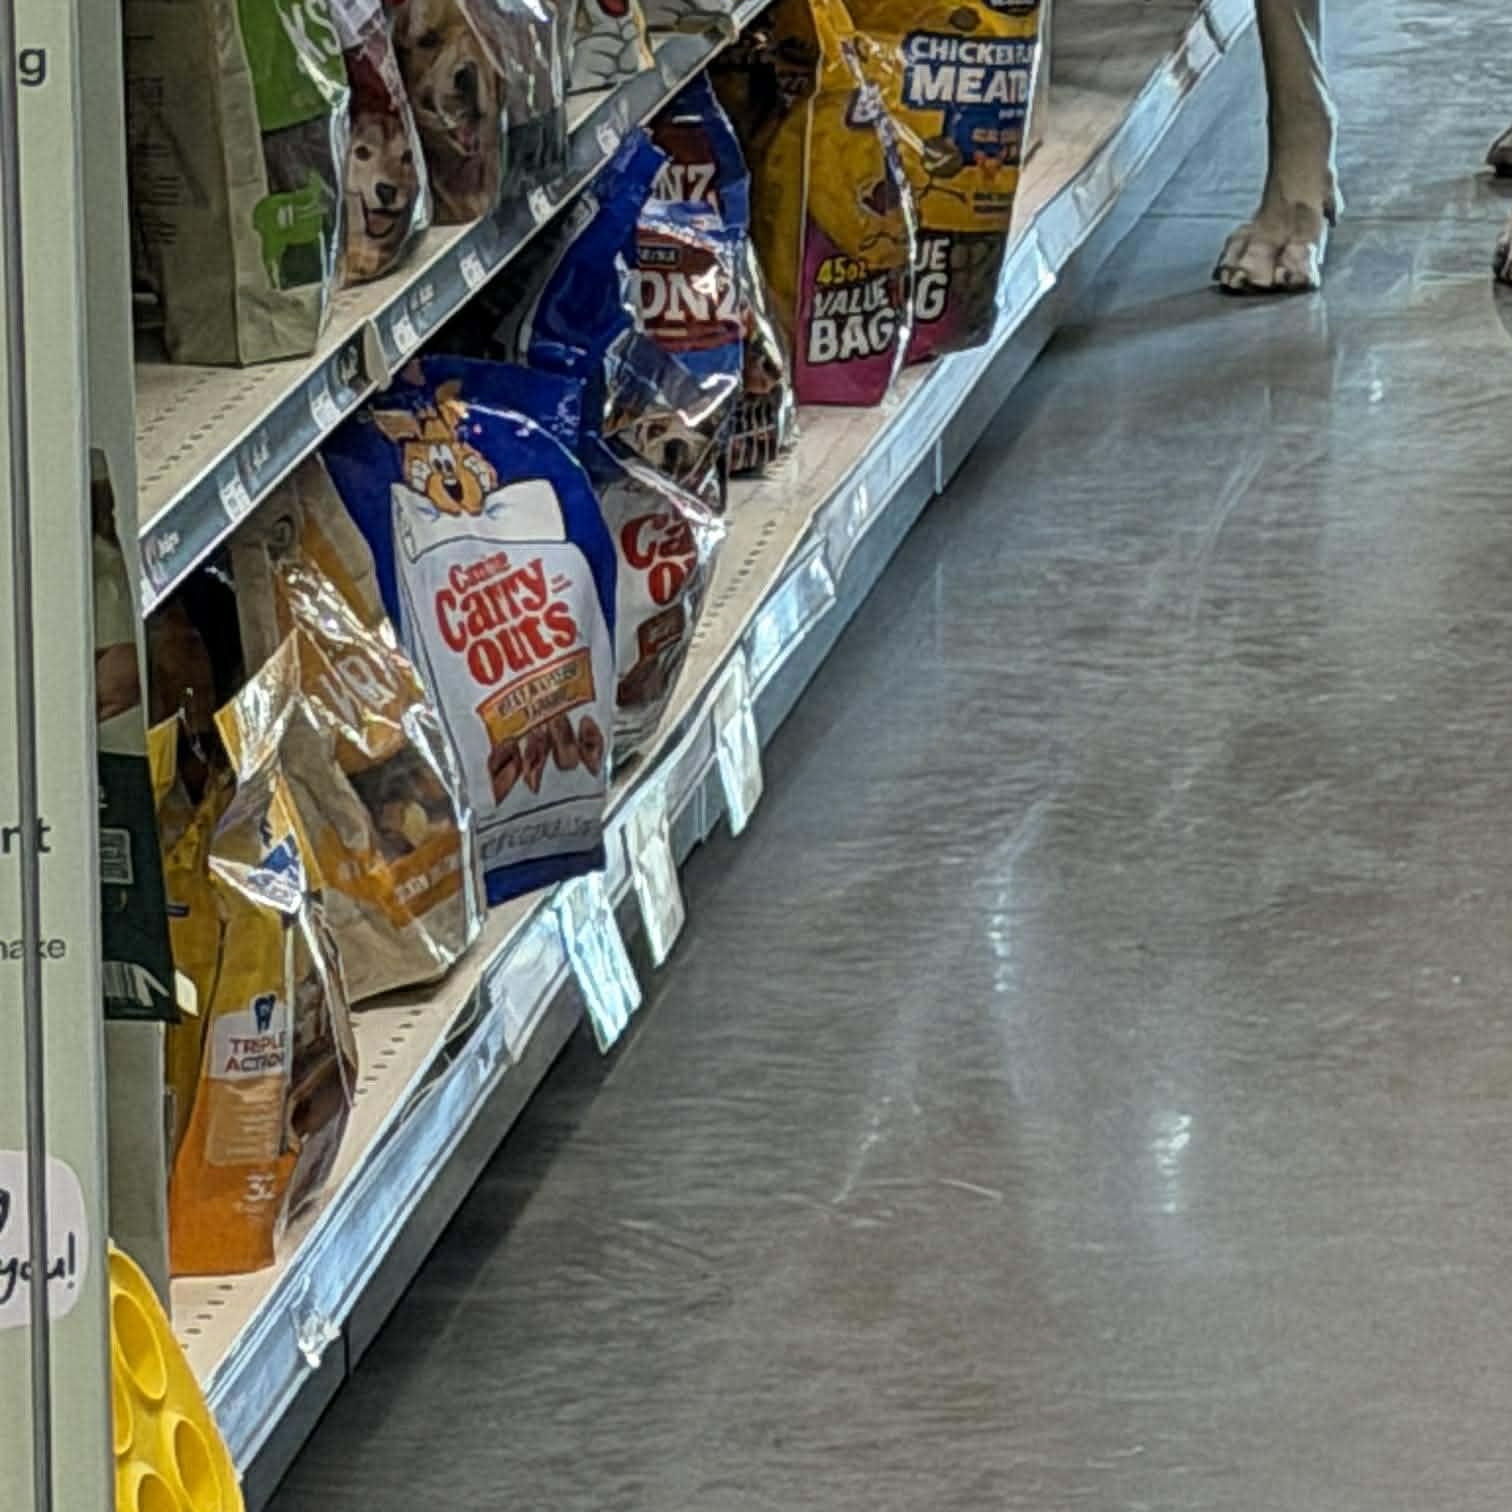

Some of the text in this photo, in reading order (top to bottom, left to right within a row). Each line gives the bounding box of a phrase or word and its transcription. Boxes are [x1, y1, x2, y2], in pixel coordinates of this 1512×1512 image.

[813, 276, 890, 318] VALUE
[808, 308, 896, 362] BAG
[435, 558, 548, 653] Carry
